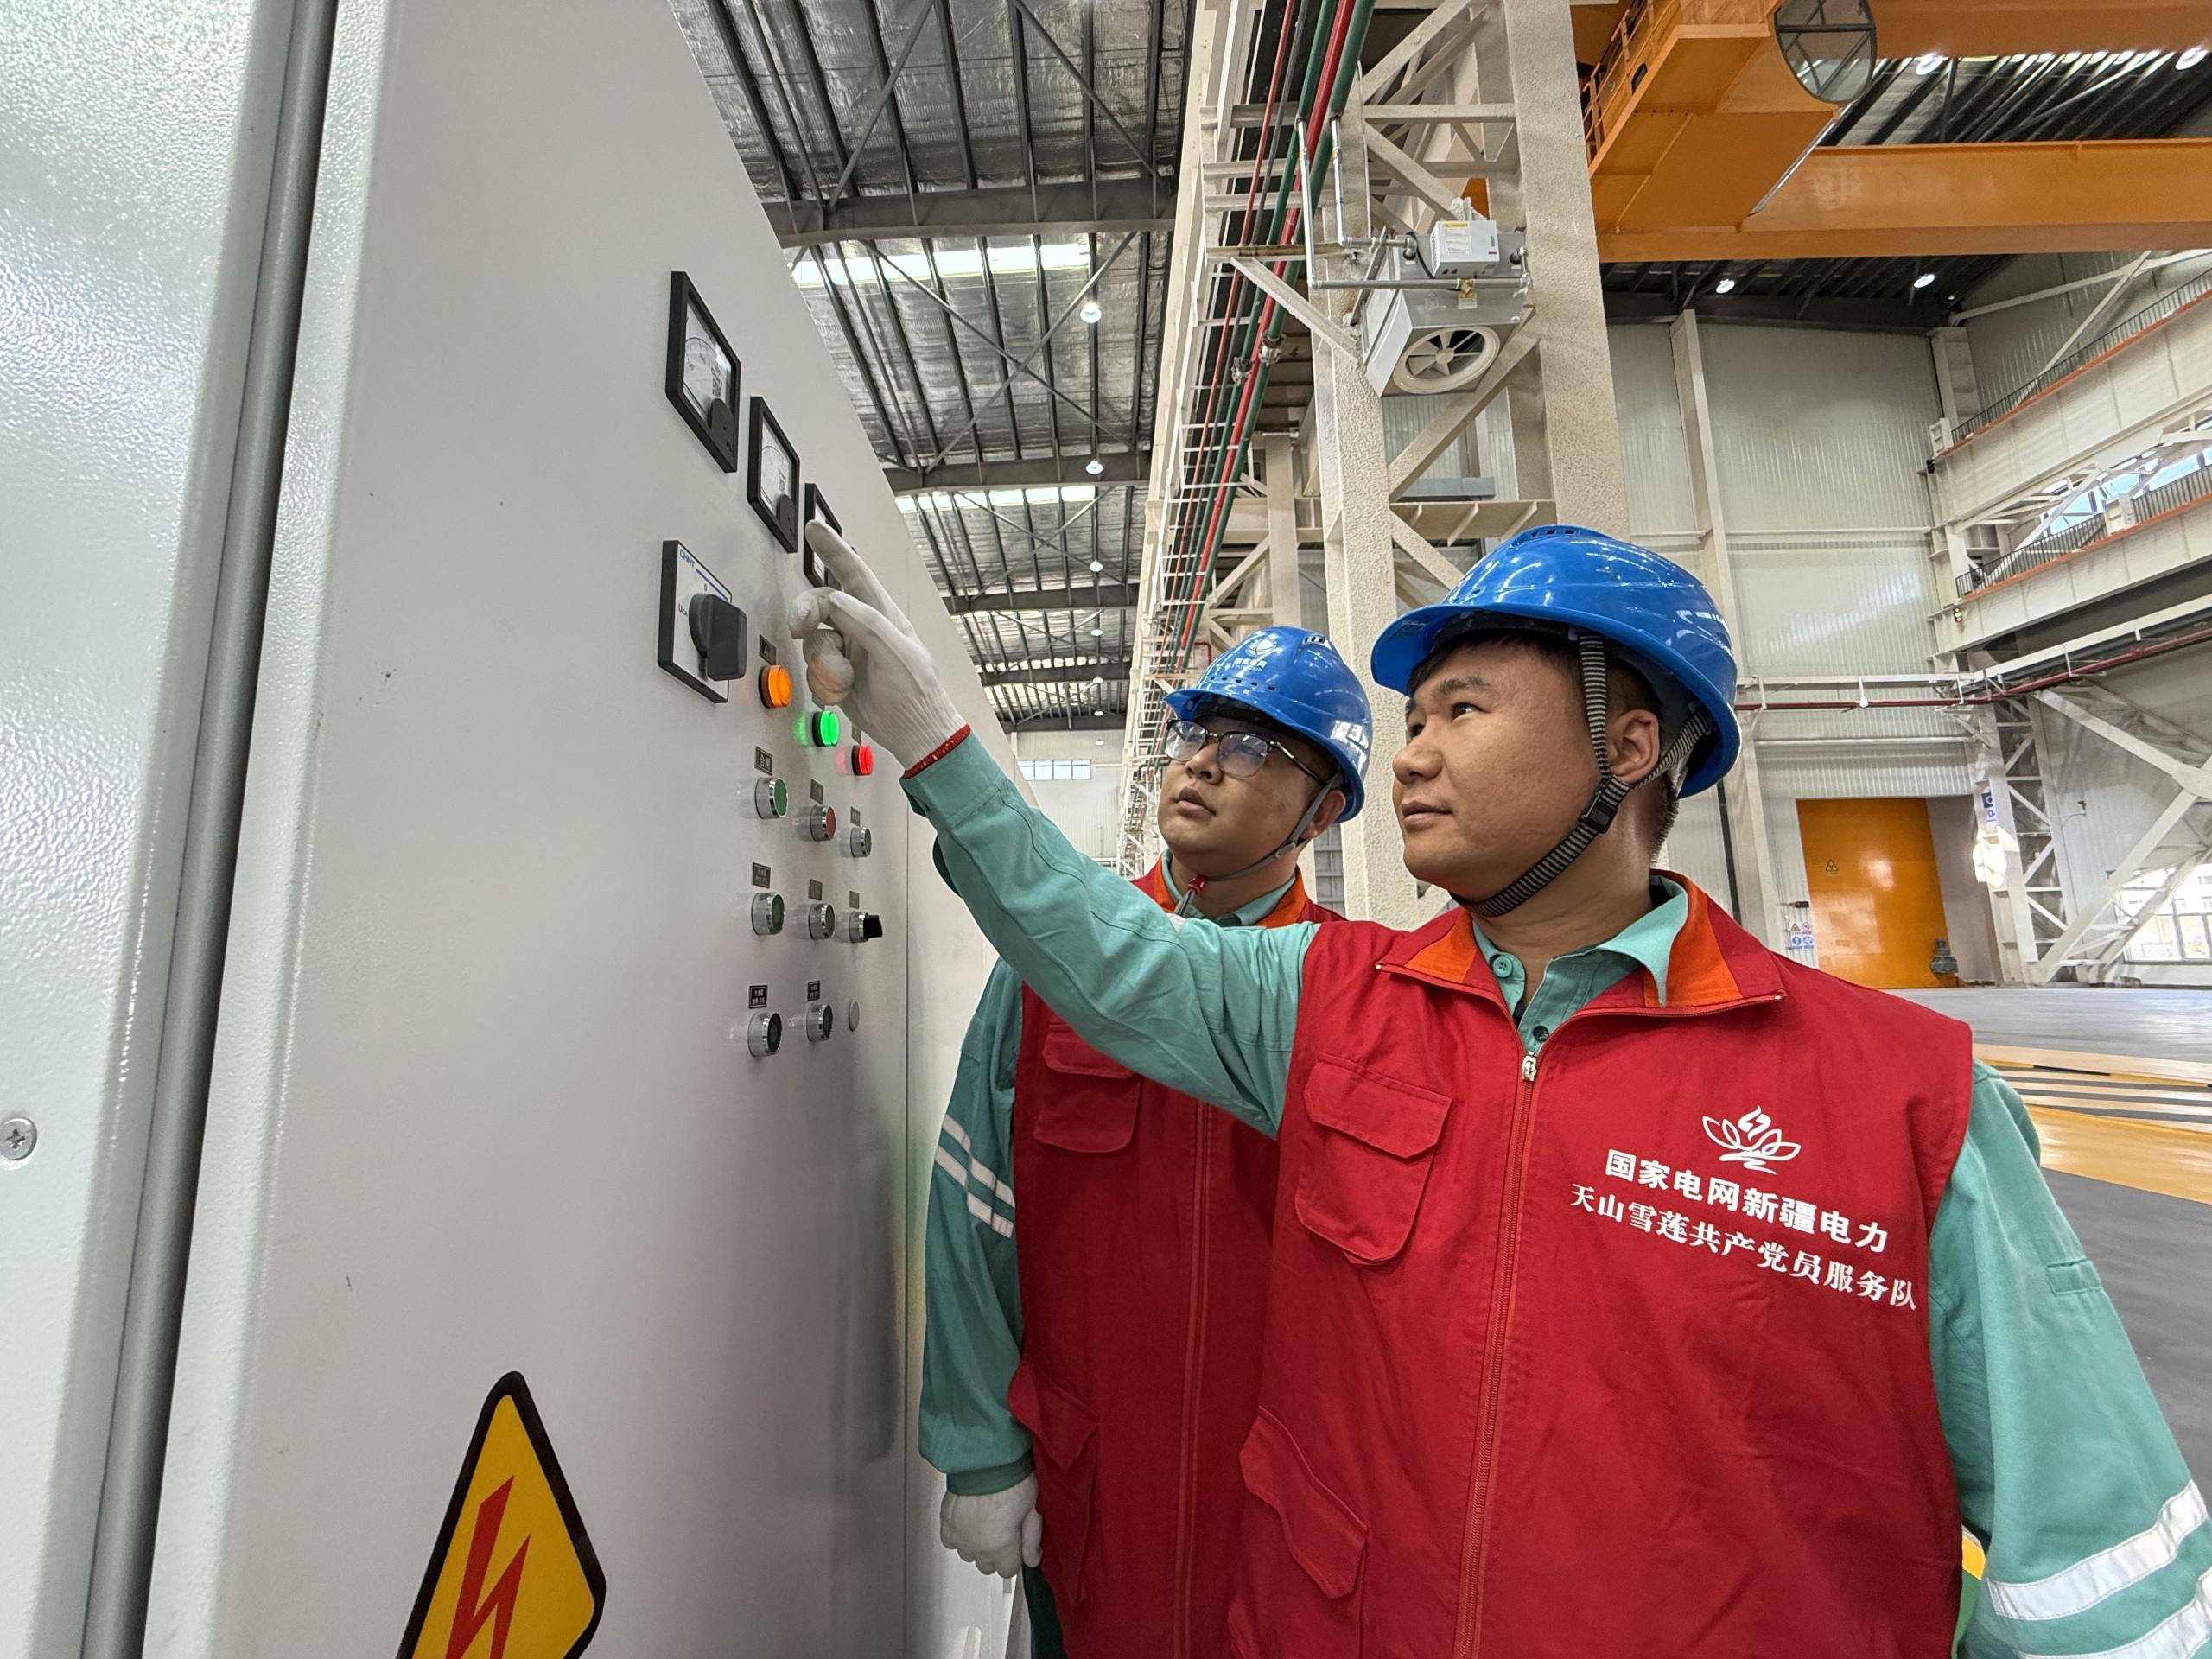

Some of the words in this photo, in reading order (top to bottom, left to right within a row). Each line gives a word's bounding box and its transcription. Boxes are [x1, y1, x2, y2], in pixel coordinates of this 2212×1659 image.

[1570, 1183, 1916, 1311] 天山雪莲共产党员服务队
[1605, 1148, 1888, 1253] 国家电网新疆电力
